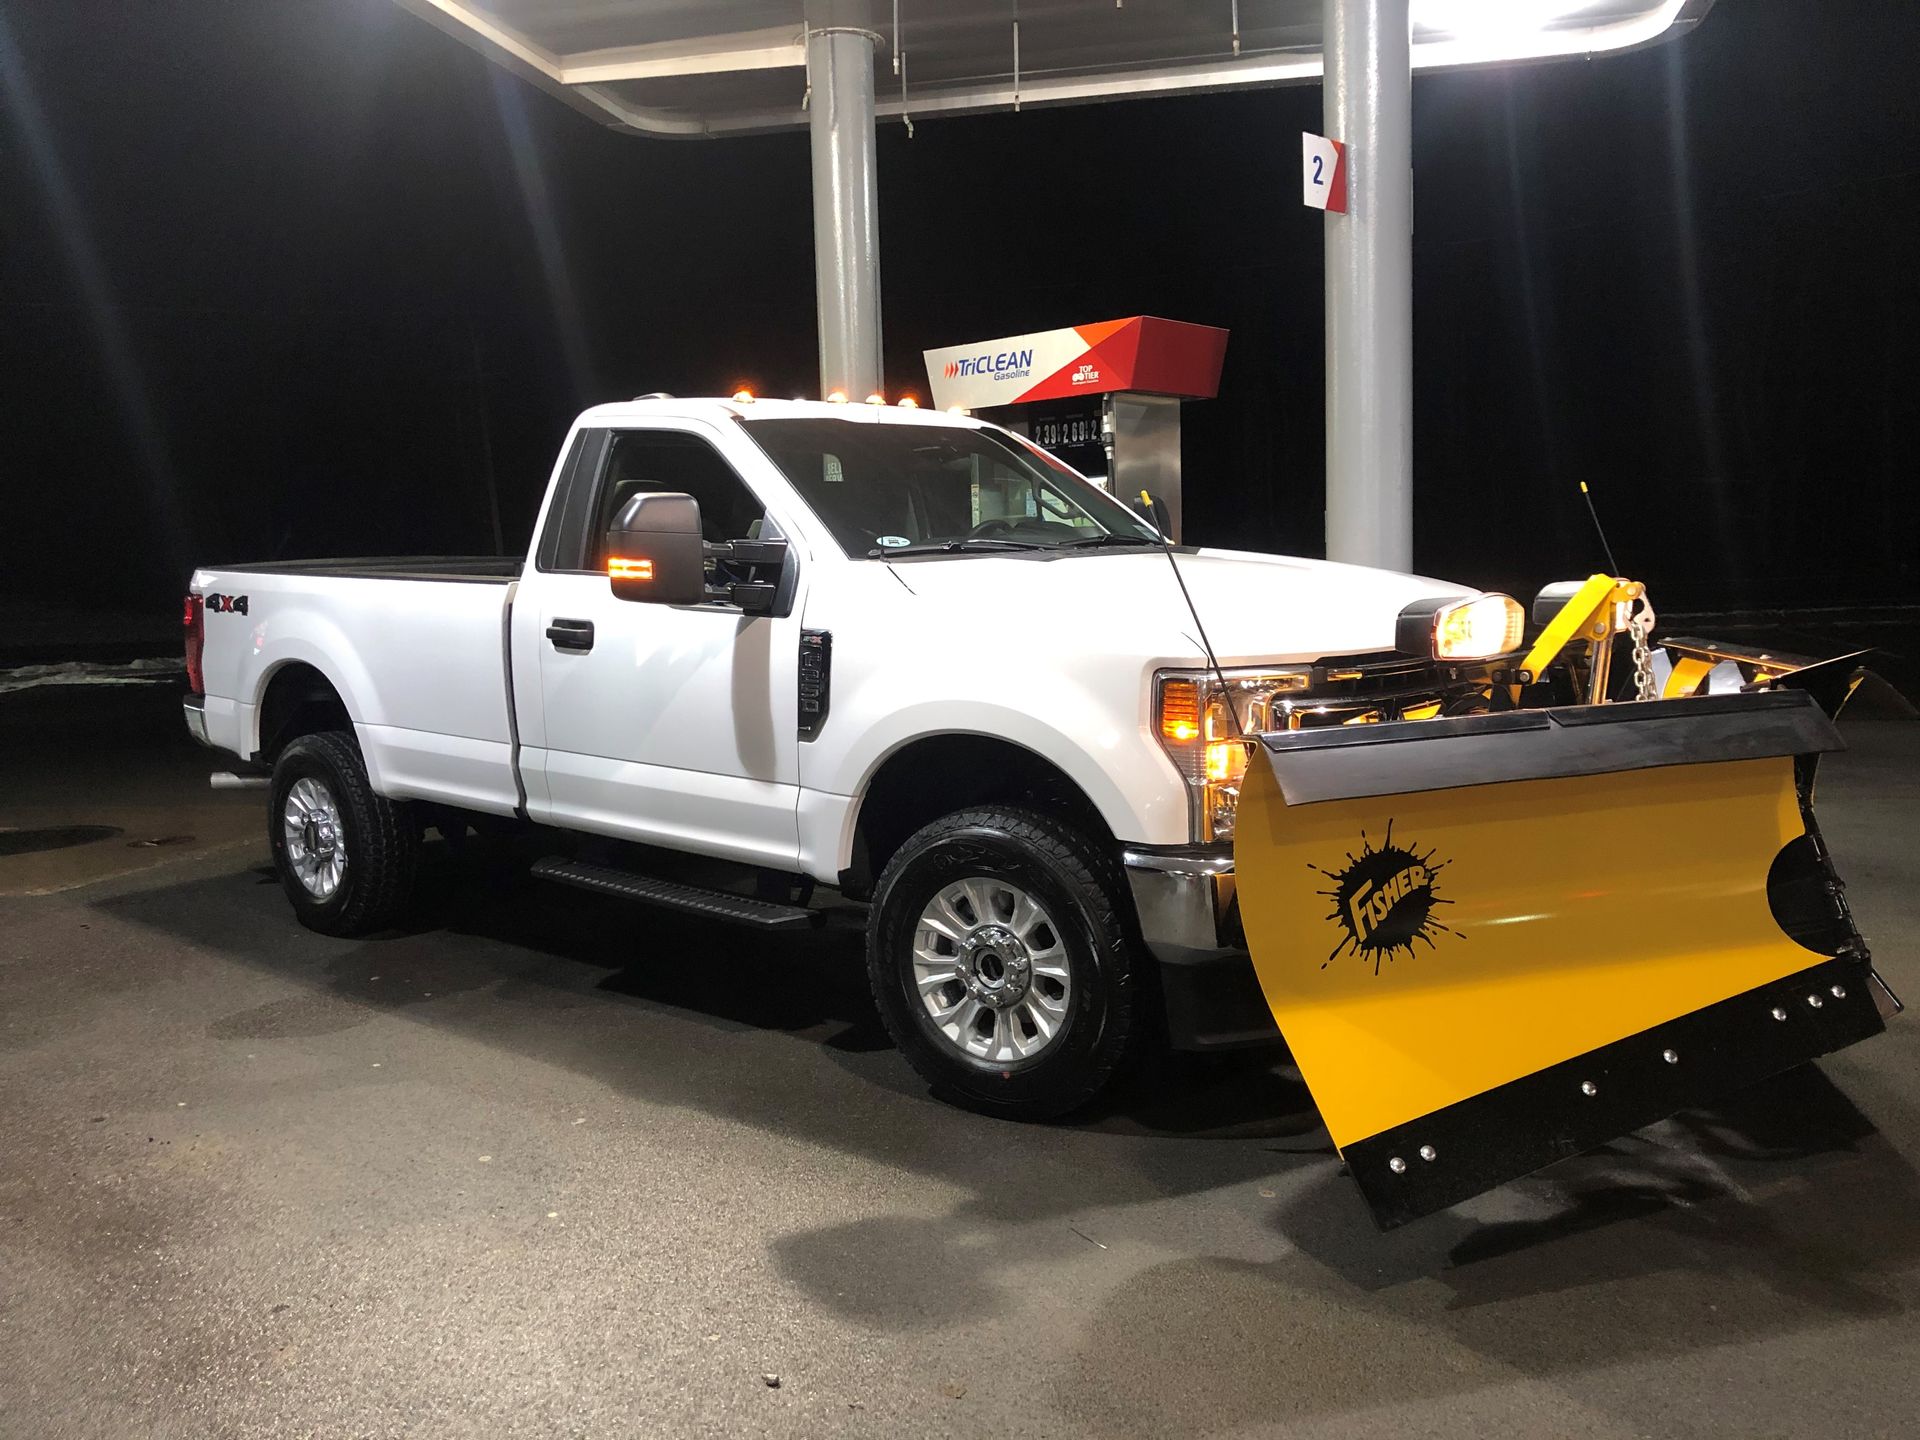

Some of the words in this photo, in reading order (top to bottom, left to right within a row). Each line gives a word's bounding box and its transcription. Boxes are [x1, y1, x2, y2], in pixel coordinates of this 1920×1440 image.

[1313, 155, 1324, 185] 2
[959, 349, 1033, 376] TriCLEAN
[1078, 364, 1093, 374] TOP
[993, 370, 1030, 381] Gasoline
[1084, 370, 1099, 380] TIER
[1349, 866, 1429, 943] FISHER
